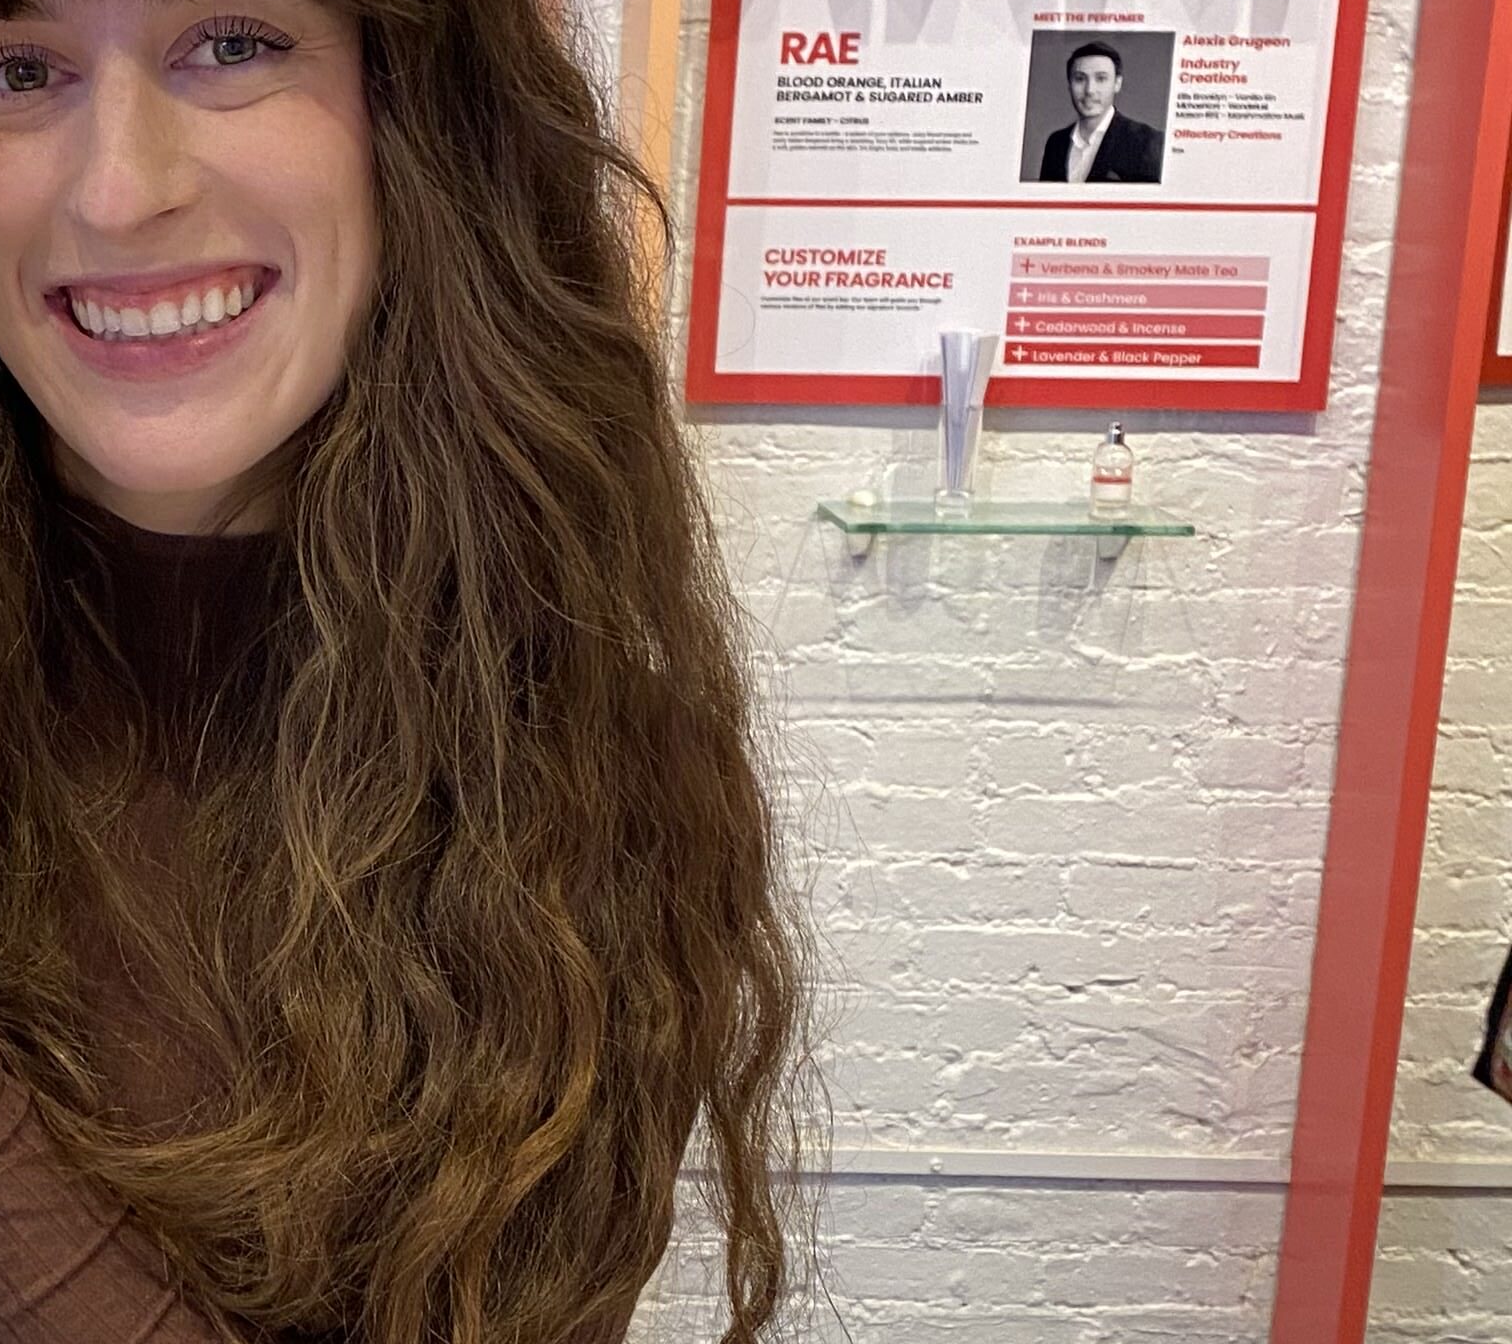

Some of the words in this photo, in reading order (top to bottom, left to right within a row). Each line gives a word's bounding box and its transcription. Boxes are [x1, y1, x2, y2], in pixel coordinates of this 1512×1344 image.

[1034, 13, 1061, 22] MEET
[1065, 13, 1085, 23] THE
[1088, 13, 1145, 23] PERFUMER
[780, 31, 861, 65] RAE
[1182, 35, 1225, 47] Alexis
[1180, 58, 1240, 73] Industry
[777, 76, 824, 89] BLOOD
[826, 76, 887, 91] ORANGE,
[890, 77, 942, 89] ITALIAN
[1179, 72, 1247, 84] Creations
[776, 90, 852, 103] BERGAMOT
[854, 91, 865, 103] &
[868, 91, 933, 103] SUGARED
[936, 92, 984, 104] AMBER
[1173, 129, 1224, 142] Olfactory
[1228, 130, 1282, 140] Creations
[1014, 237, 1063, 247] EXAMPLE
[1065, 237, 1107, 248] BLENDS
[764, 249, 887, 266] CUSTOMIZE
[1041, 263, 1099, 275] Verbena
[1103, 264, 1113, 275] &
[1117, 264, 1171, 279] Smokey
[1174, 265, 1210, 276] Mate
[1213, 265, 1238, 276] Tea
[763, 271, 821, 288] YOUR
[824, 272, 954, 289] FRAGRANCE
[1038, 291, 1056, 303] Iris
[1060, 292, 1071, 304] &
[1074, 292, 1148, 304] Cashmere
[1035, 321, 1116, 334] Cedarwood
[1118, 322, 1129, 334] &
[1132, 322, 1187, 335] Incense
[1032, 350, 1096, 361] Lavender
[1099, 351, 1109, 362] &
[1112, 350, 1149, 363] Black
[1153, 352, 1202, 367] Pepper
